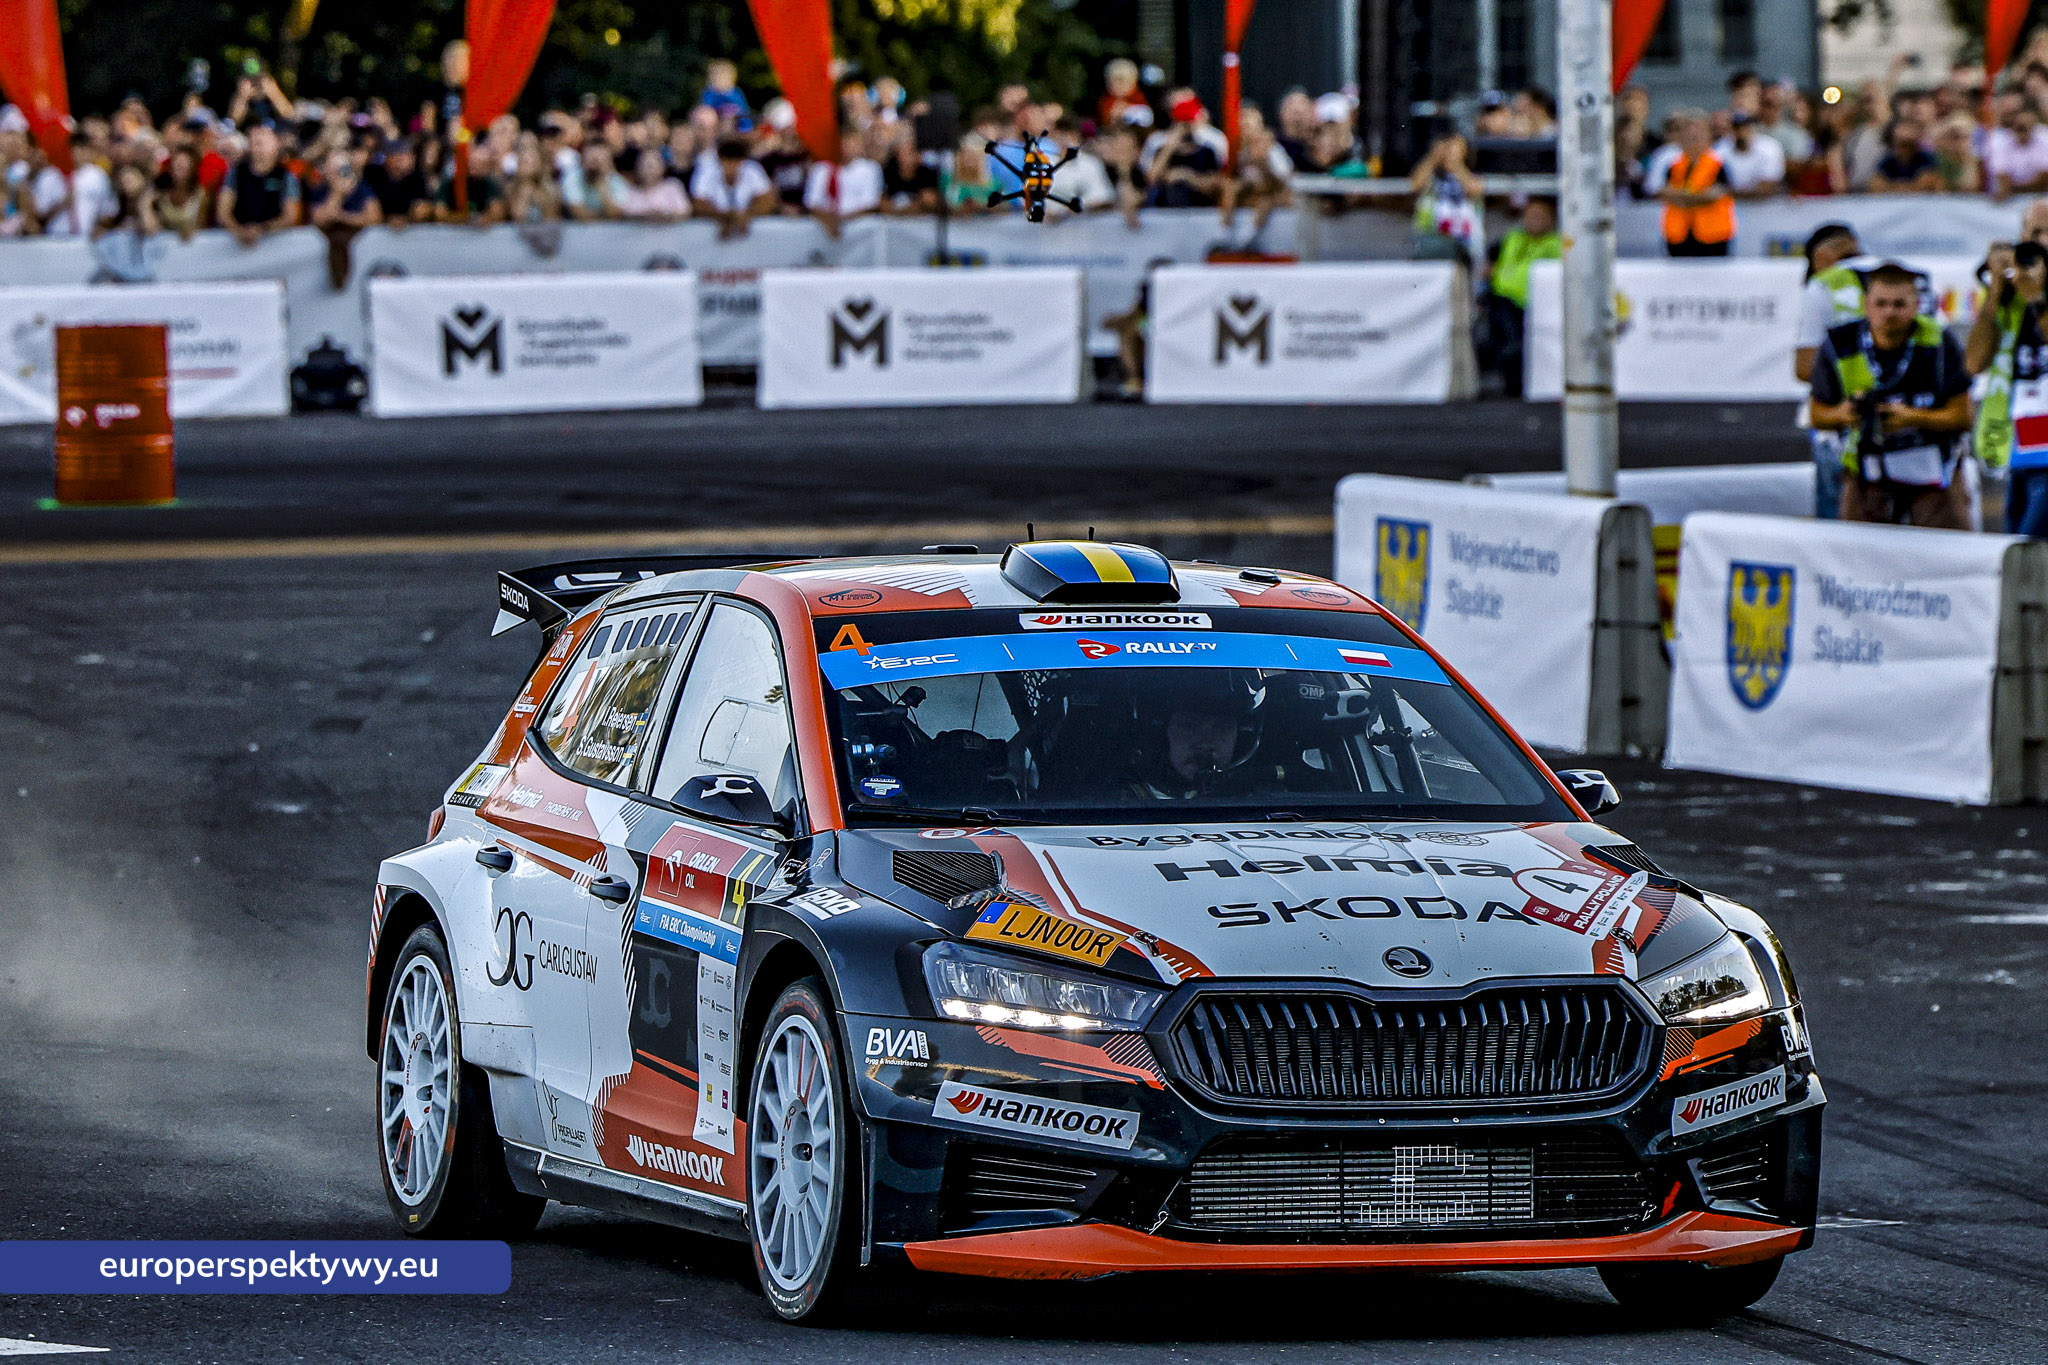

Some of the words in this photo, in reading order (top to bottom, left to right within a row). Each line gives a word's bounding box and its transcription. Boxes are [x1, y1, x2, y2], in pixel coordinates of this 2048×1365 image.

[501, 583, 529, 612] SKODA
[1814, 573, 1951, 621] Województwo
[830, 623, 874, 656] 4
[505, 783, 545, 809] Helmia
[1086, 828, 1410, 847] ByggDialog
[688, 850, 722, 874] ORLEN
[1154, 855, 1514, 882] Helmia
[684, 874, 696, 889] OIL
[731, 853, 766, 925] 4
[1532, 874, 1590, 894] 4
[1207, 895, 1542, 928] SKODA
[1573, 898, 1602, 930] RALLY
[1596, 874, 1627, 903] POLAND
[659, 914, 670, 931] FIA
[669, 917, 682, 934] ERC
[680, 920, 717, 950] Championship
[538, 939, 599, 985] CARLGUSTAV
[865, 1027, 920, 1059] BVA
